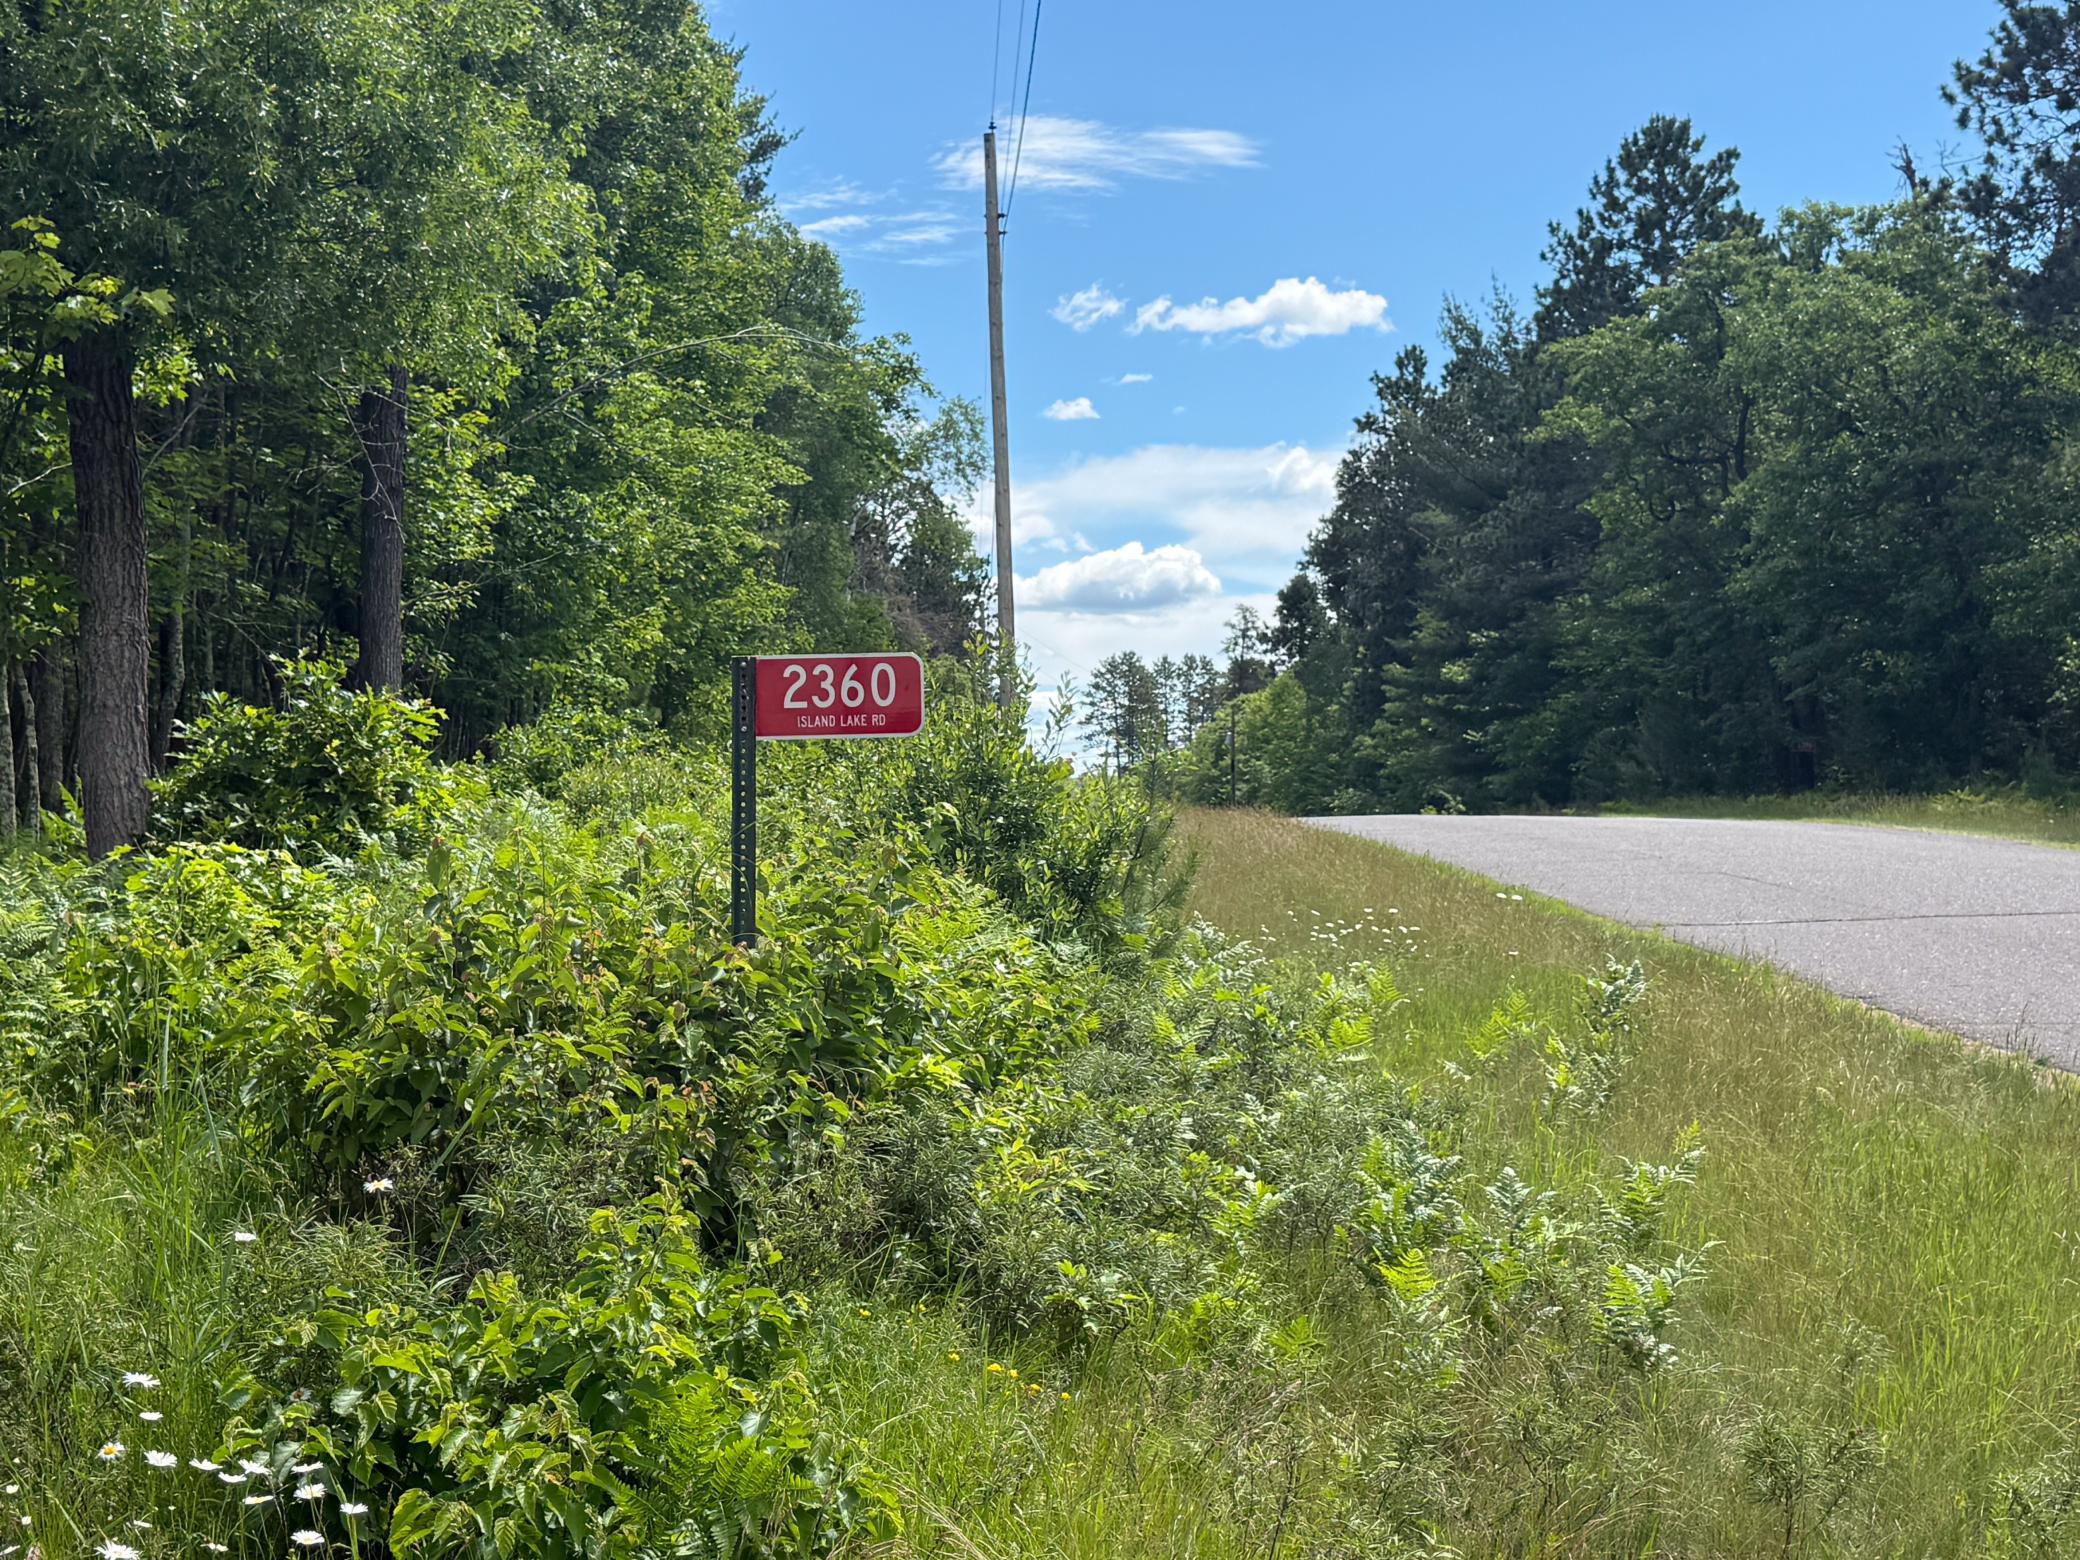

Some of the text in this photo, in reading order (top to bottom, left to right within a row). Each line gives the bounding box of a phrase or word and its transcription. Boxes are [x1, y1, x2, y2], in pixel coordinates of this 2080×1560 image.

[783, 663, 896, 709] 2360
[797, 714, 886, 728] ISLAND LAKE RD
